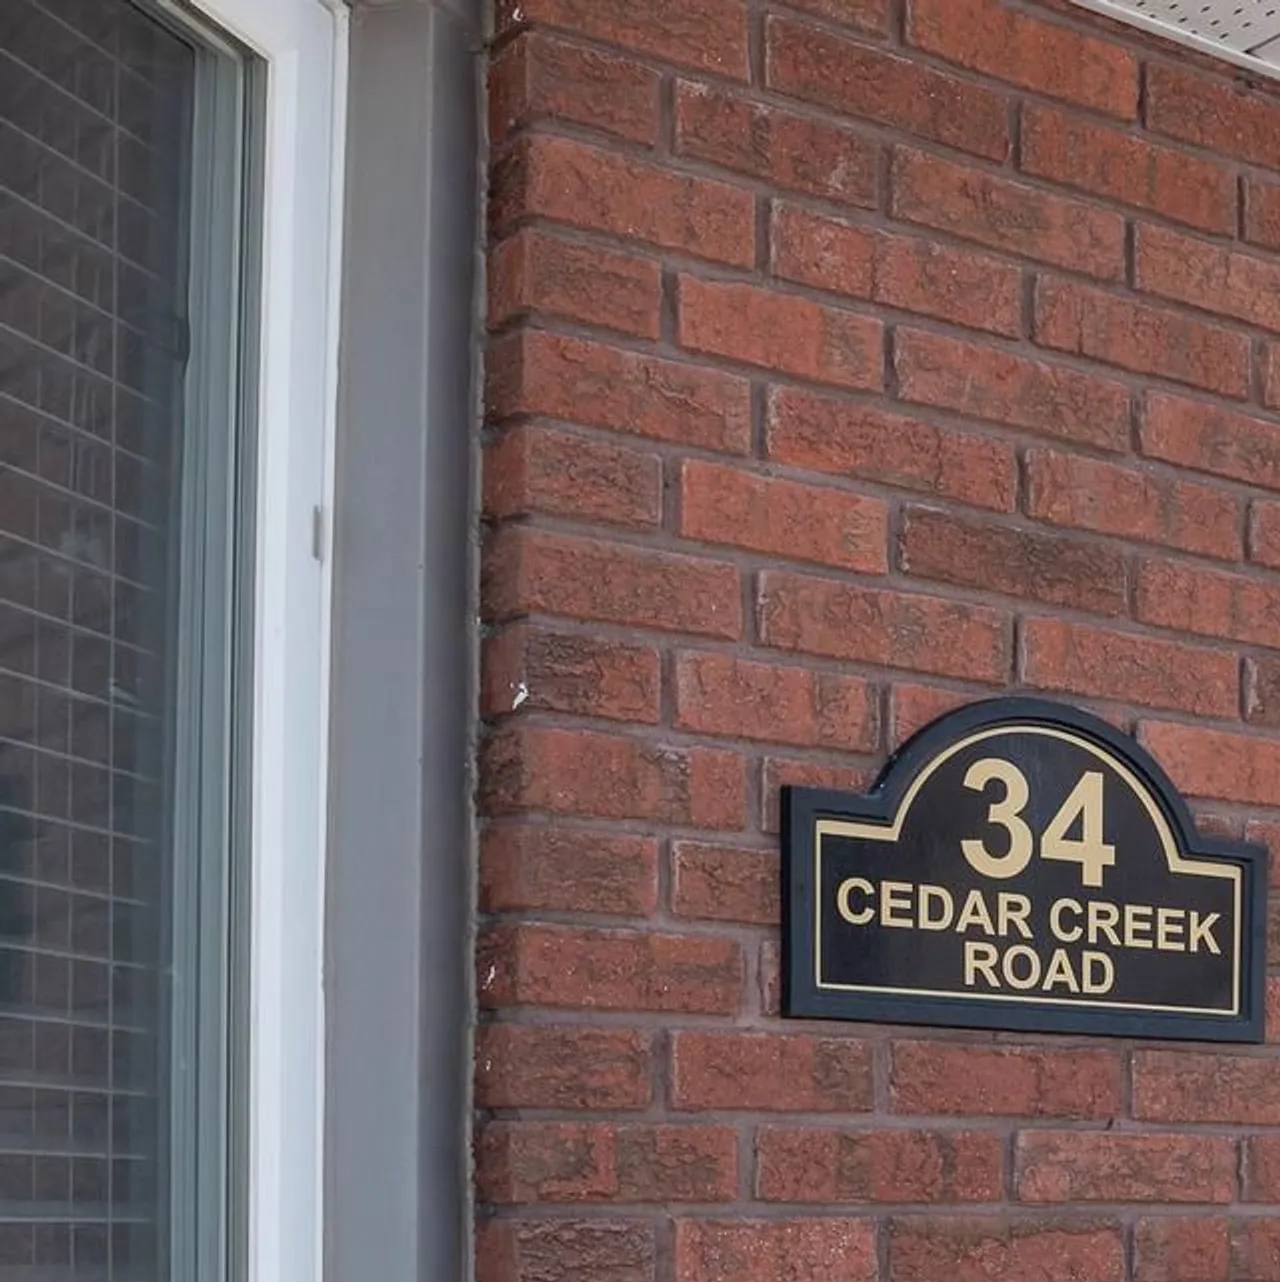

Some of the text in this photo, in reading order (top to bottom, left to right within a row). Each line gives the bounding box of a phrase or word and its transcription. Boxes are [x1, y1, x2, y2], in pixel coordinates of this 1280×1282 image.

[960, 757, 1116, 888] 34
[836, 876, 1222, 955] CEDAR CREEK
[963, 941, 1115, 995] ROAD
